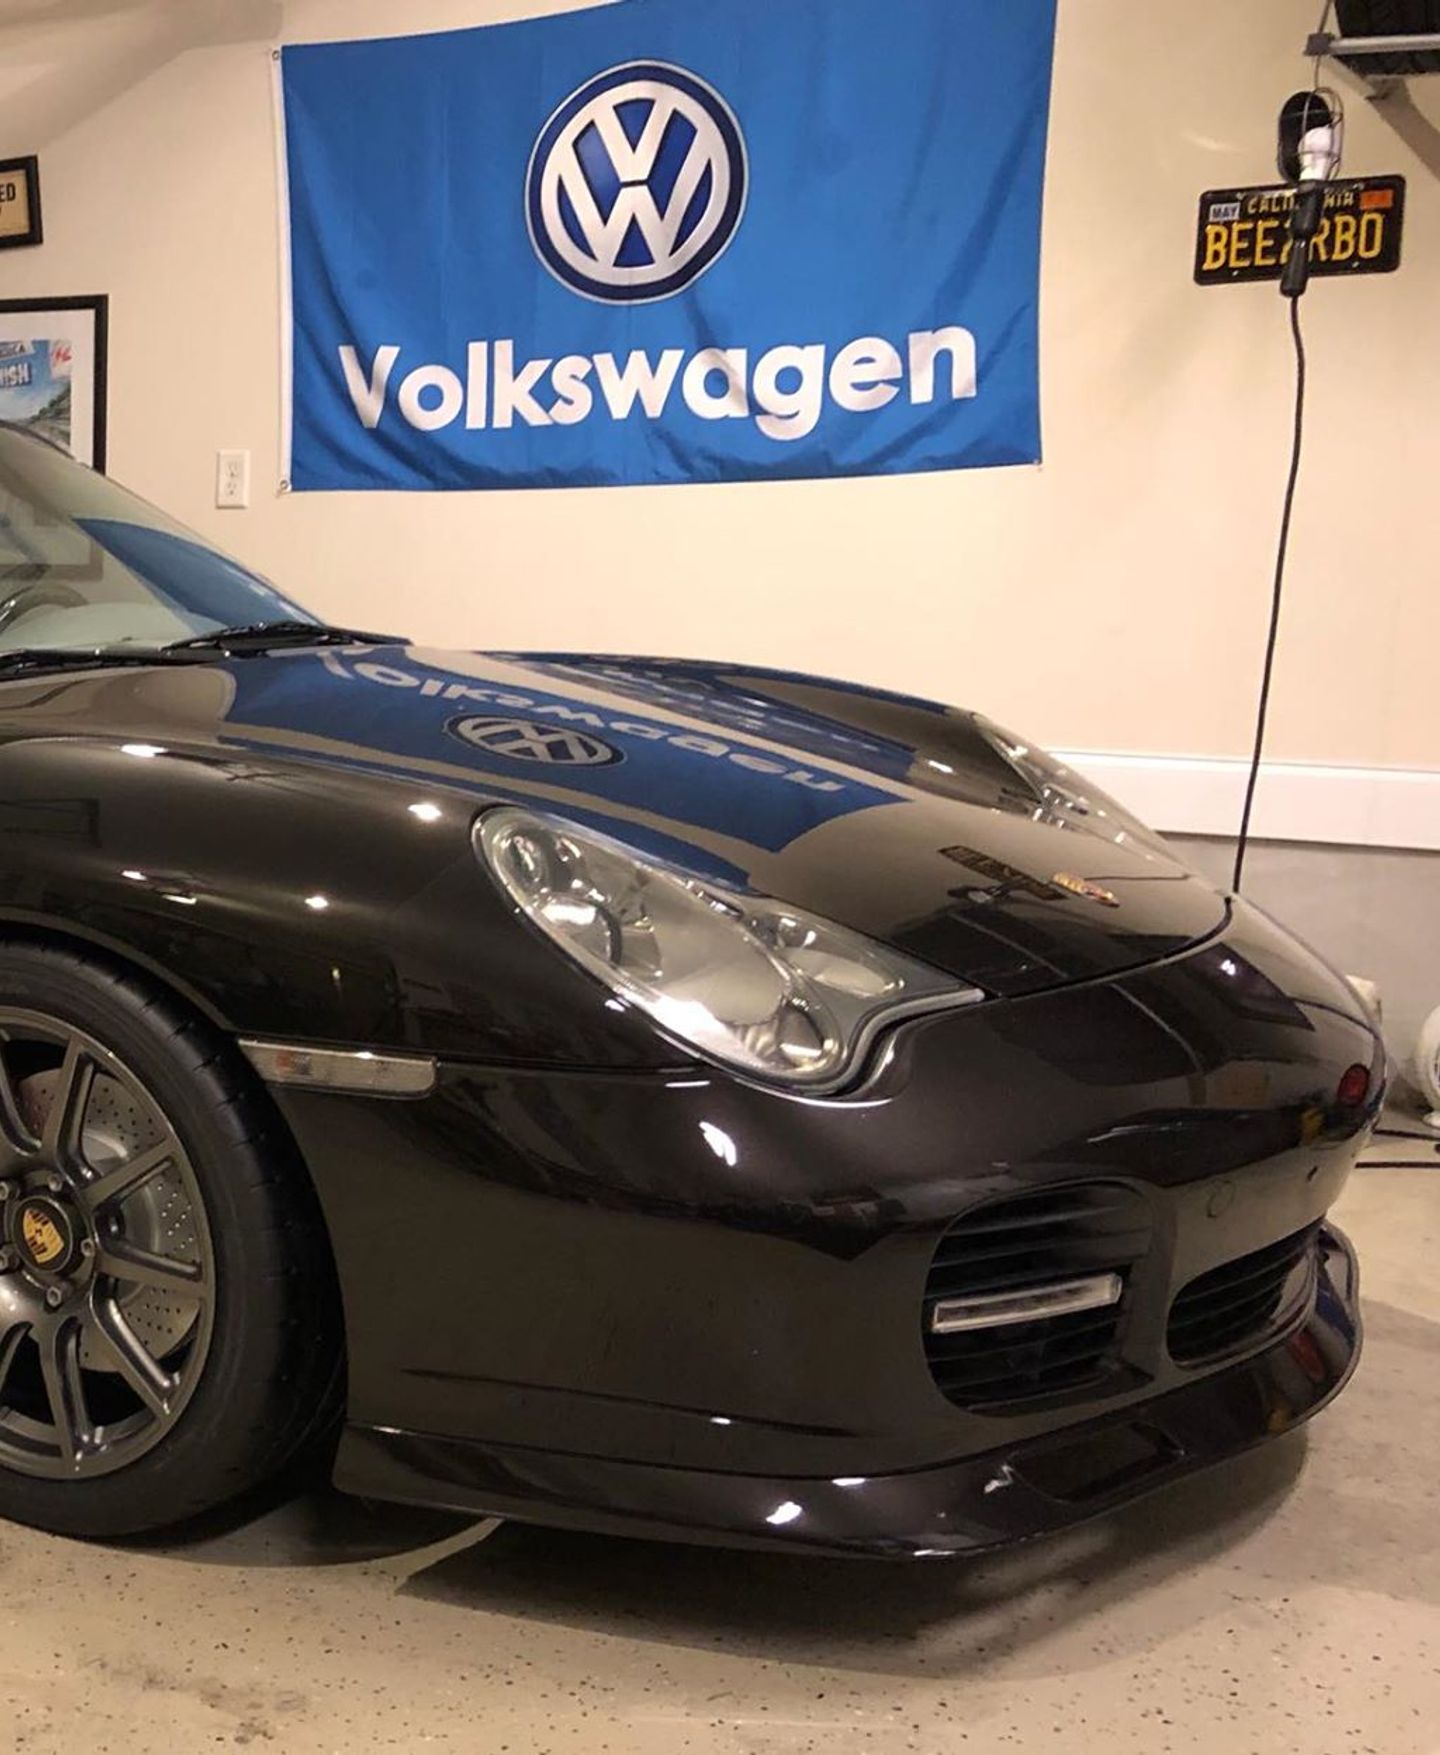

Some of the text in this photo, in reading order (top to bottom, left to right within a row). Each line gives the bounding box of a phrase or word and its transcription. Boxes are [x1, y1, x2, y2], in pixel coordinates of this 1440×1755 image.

[538, 76, 733, 286] VW
[1211, 204, 1239, 220] MAY
[337, 325, 977, 440] Volkswagen
